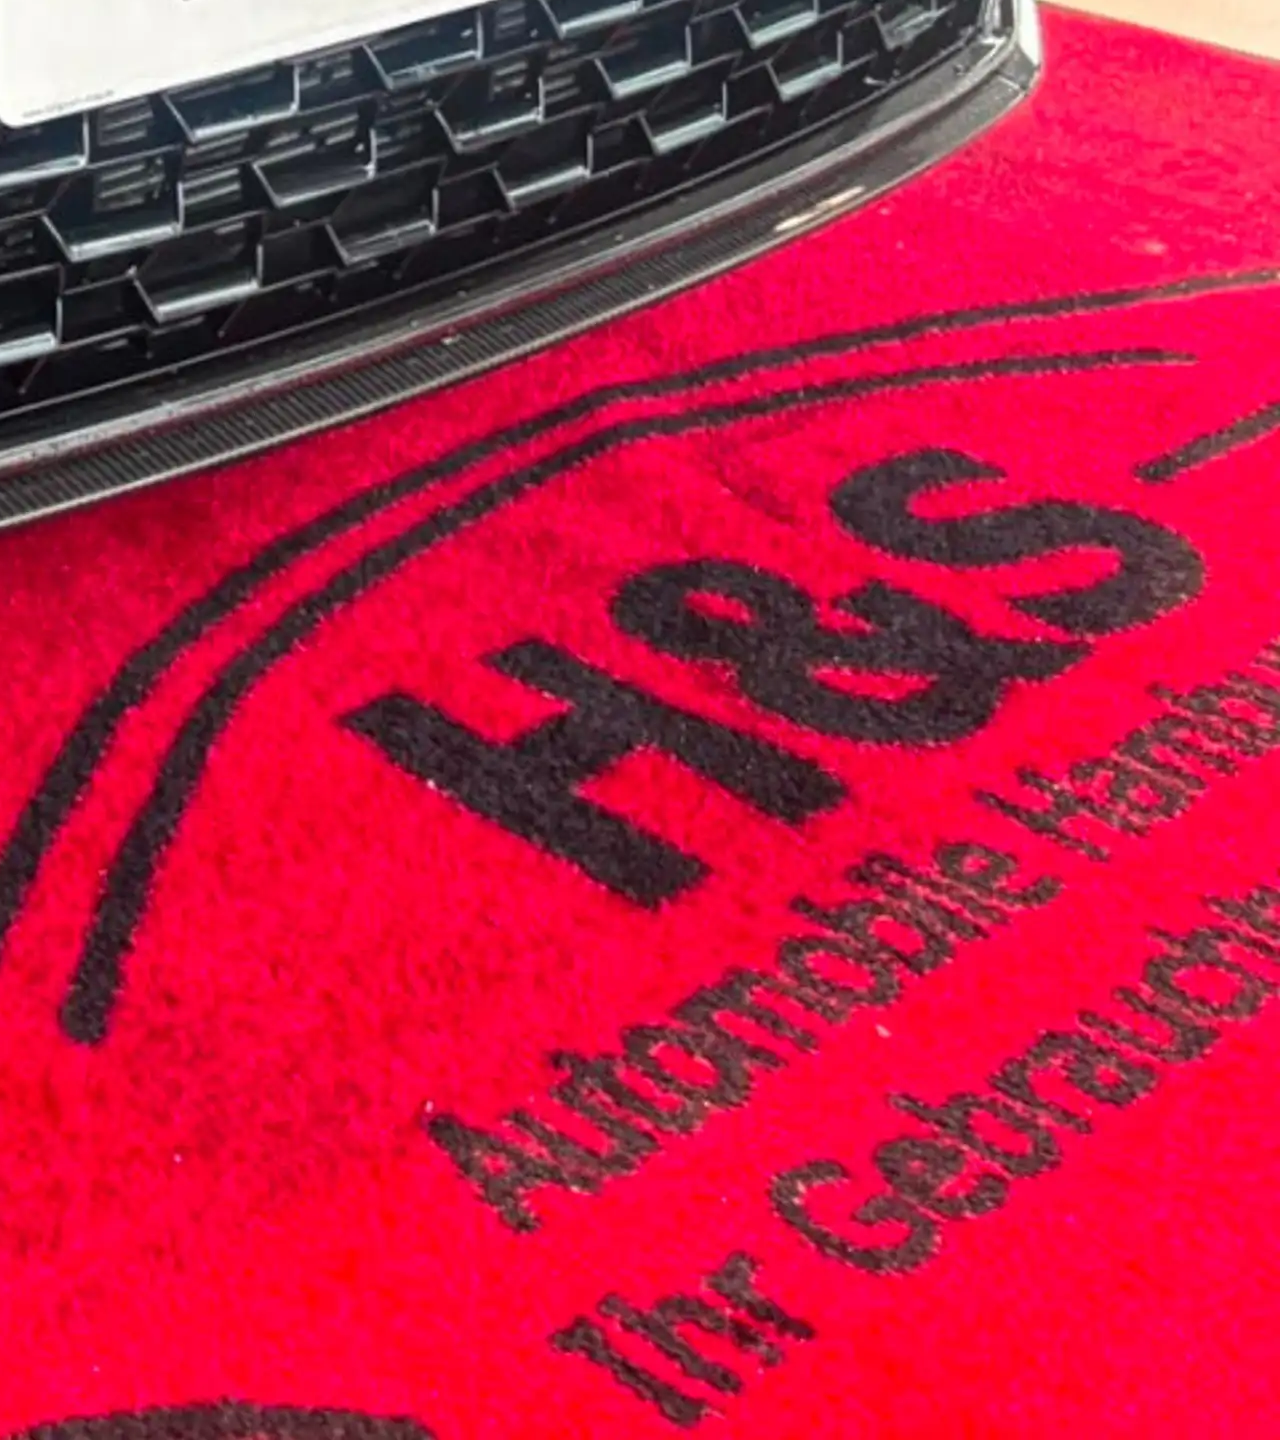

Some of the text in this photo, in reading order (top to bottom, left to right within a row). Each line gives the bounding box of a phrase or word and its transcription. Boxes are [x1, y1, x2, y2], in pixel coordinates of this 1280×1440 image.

[338, 446, 1206, 912] H&S
[426, 841, 1065, 1234] Automobile
[549, 1250, 816, 1428] Ihr
